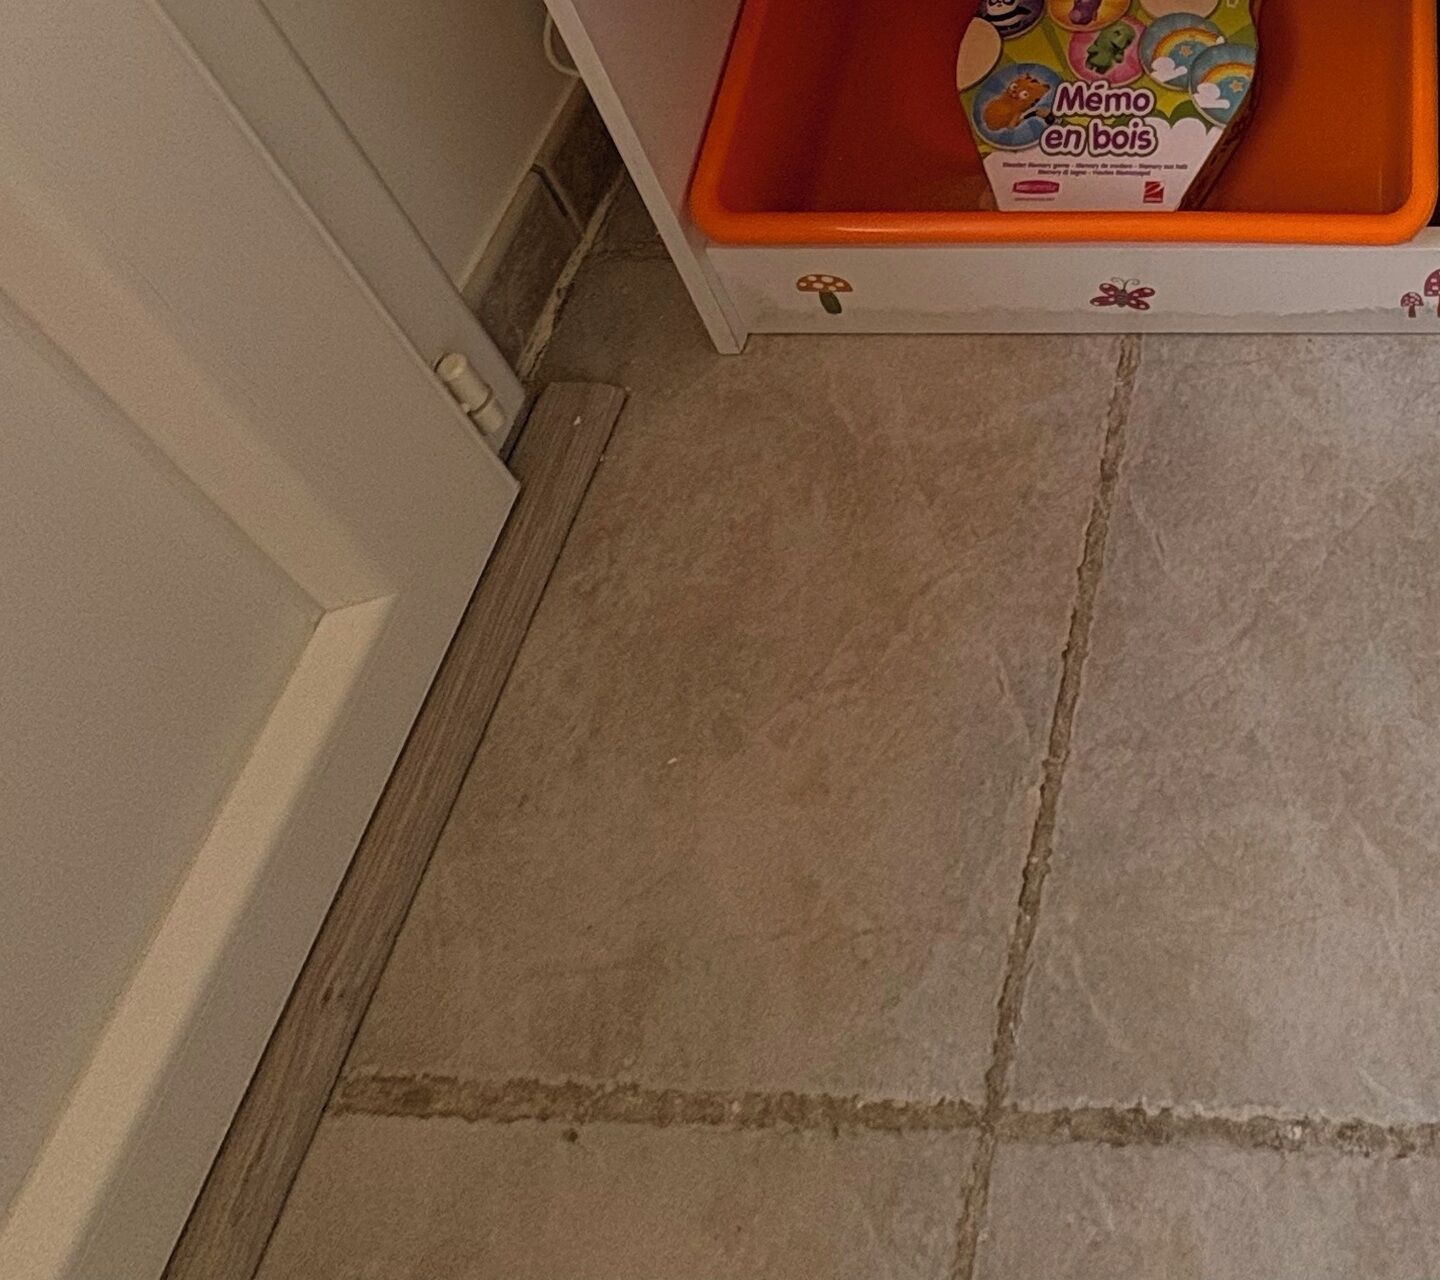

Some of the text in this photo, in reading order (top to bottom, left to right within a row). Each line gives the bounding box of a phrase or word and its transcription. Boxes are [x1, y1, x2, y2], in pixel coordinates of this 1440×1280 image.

[1055, 83, 1151, 114] Mémo
[1044, 121, 1154, 151] en bois
